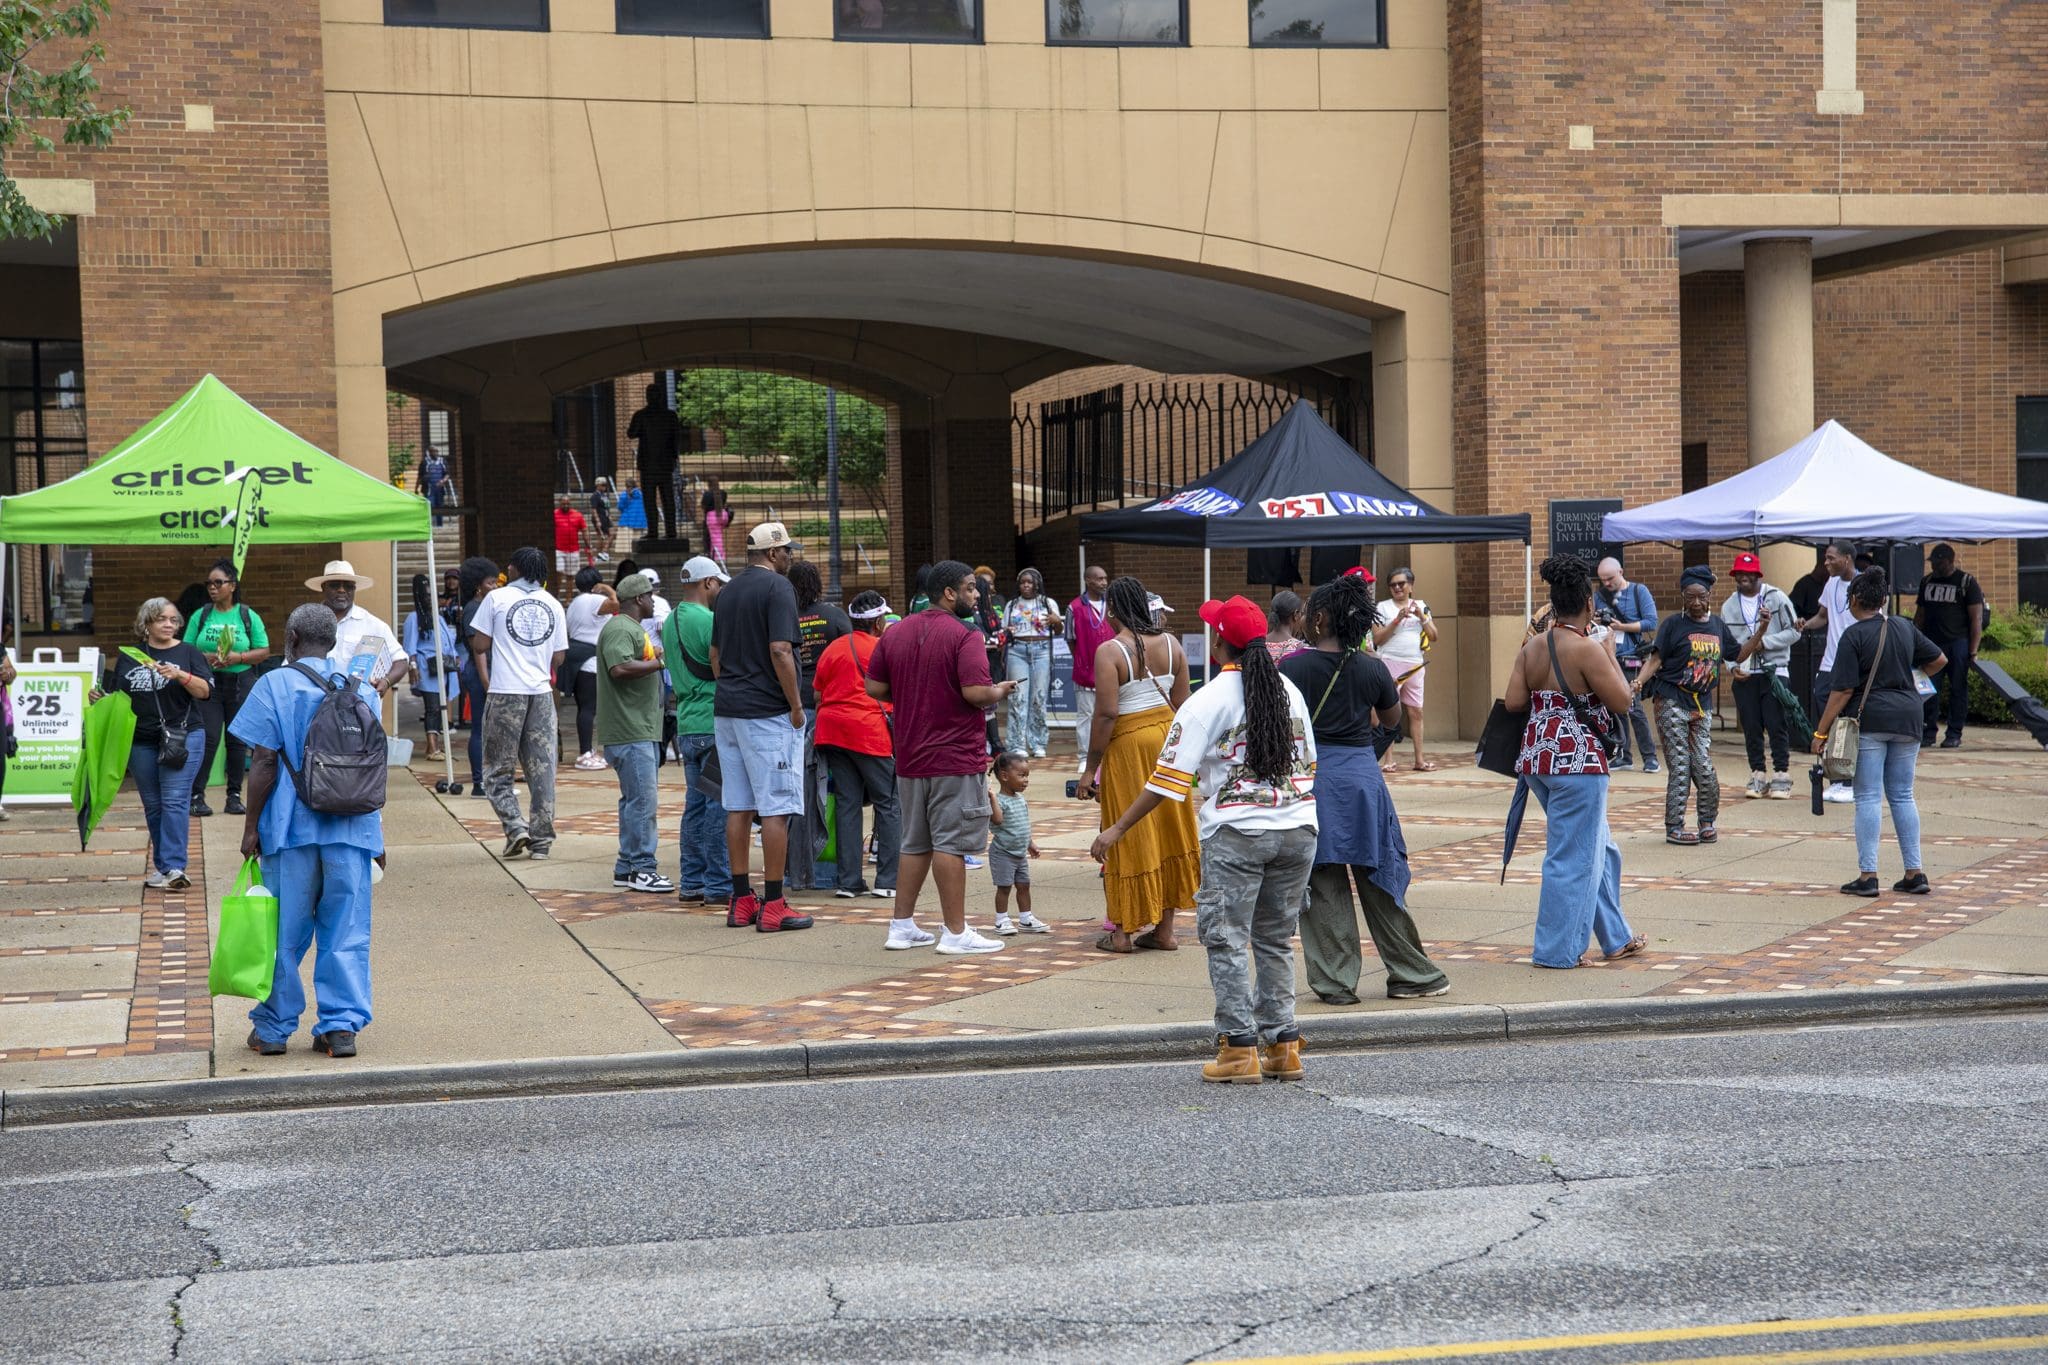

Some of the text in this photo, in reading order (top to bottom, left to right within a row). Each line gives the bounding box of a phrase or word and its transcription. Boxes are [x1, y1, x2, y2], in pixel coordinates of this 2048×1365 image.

[112, 460, 313, 488] cricket
[160, 506, 270, 529] crickt
[1556, 511, 1604, 522] BIRMINGH
[1556, 522, 1602, 532] CIVIL RIG
[161, 531, 199, 539] wireless
[1556, 532, 1603, 542] INSTITU
[1578, 548, 1598, 559] 520
[1692, 640, 1720, 654] OUTTA
[24, 680, 70, 692] NEW!
[18, 695, 61, 716] $25
[22, 719, 69, 727] Unlimited
[38, 727, 58, 735] Line
[37, 747, 53, 755] you
[55, 745, 79, 755] bring
[20, 753, 70, 763] your phone
[40, 762, 56, 770] fast
